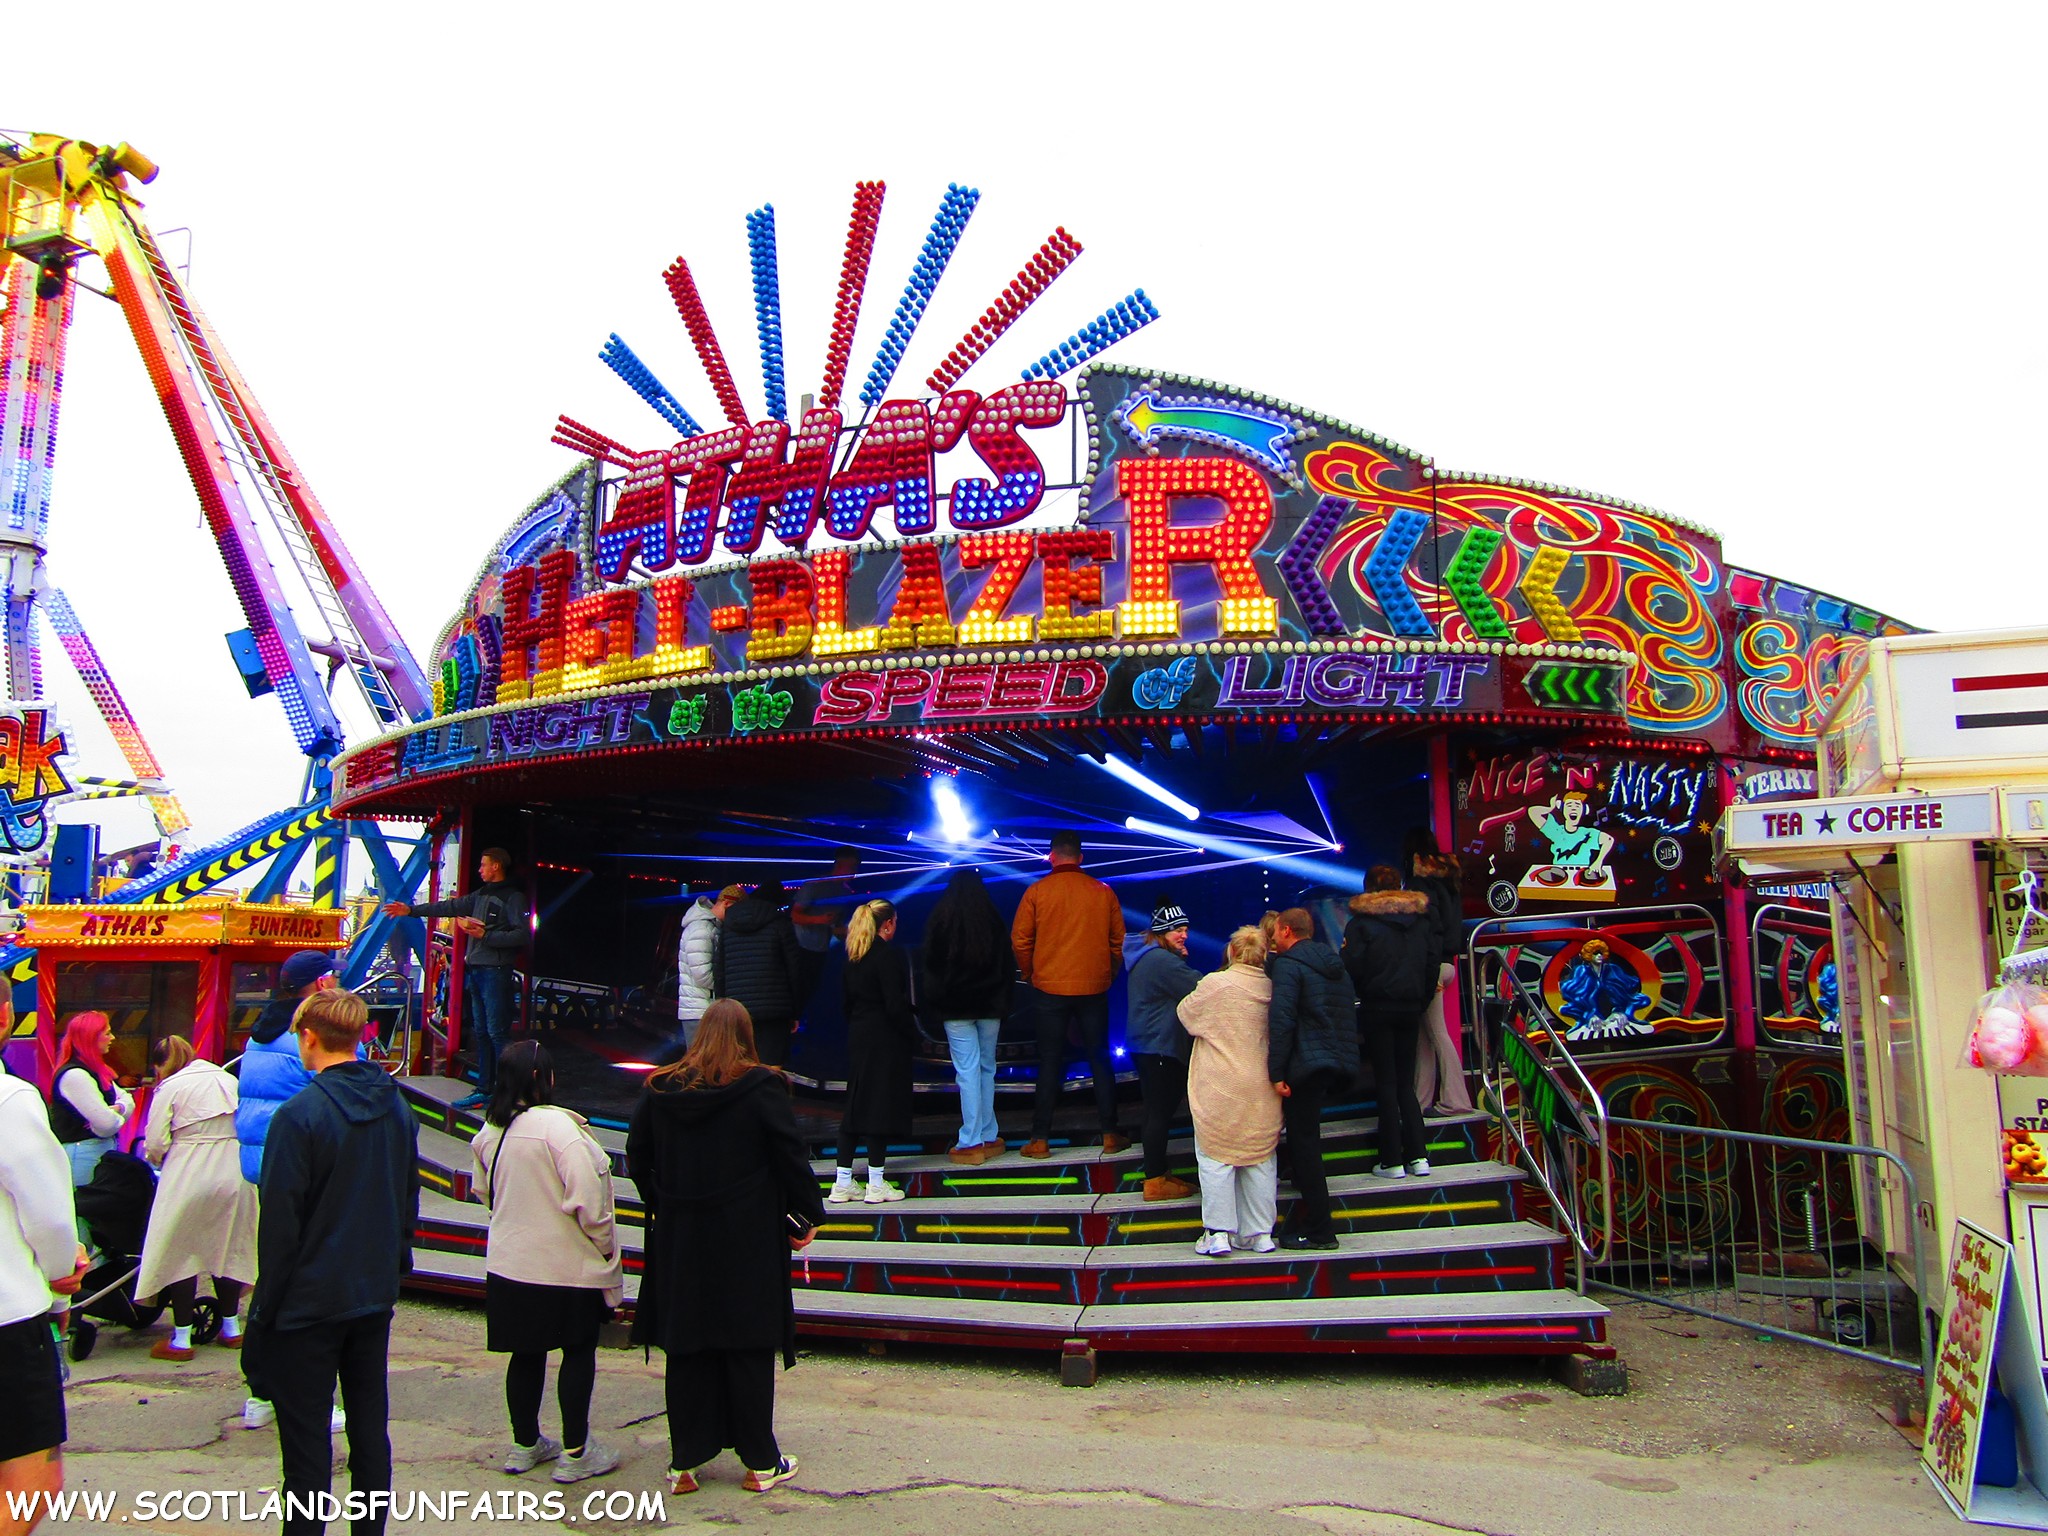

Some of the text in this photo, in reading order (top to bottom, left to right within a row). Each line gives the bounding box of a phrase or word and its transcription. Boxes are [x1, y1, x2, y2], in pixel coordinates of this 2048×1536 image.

[596, 380, 1067, 582] ATHA'S
[487, 691, 651, 758] NIGHT
[732, 681, 793, 730] the
[813, 660, 1108, 726] SPEED
[1133, 655, 1197, 709] of
[1215, 653, 1491, 708] LIGHT
[1608, 760, 1706, 817] NASTY
[1746, 768, 1815, 798] TERRY
[1762, 803, 1943, 838] TEA COFFEE
[80, 915, 169, 937] ATHA'S
[249, 916, 324, 938] FUNFAIRS
